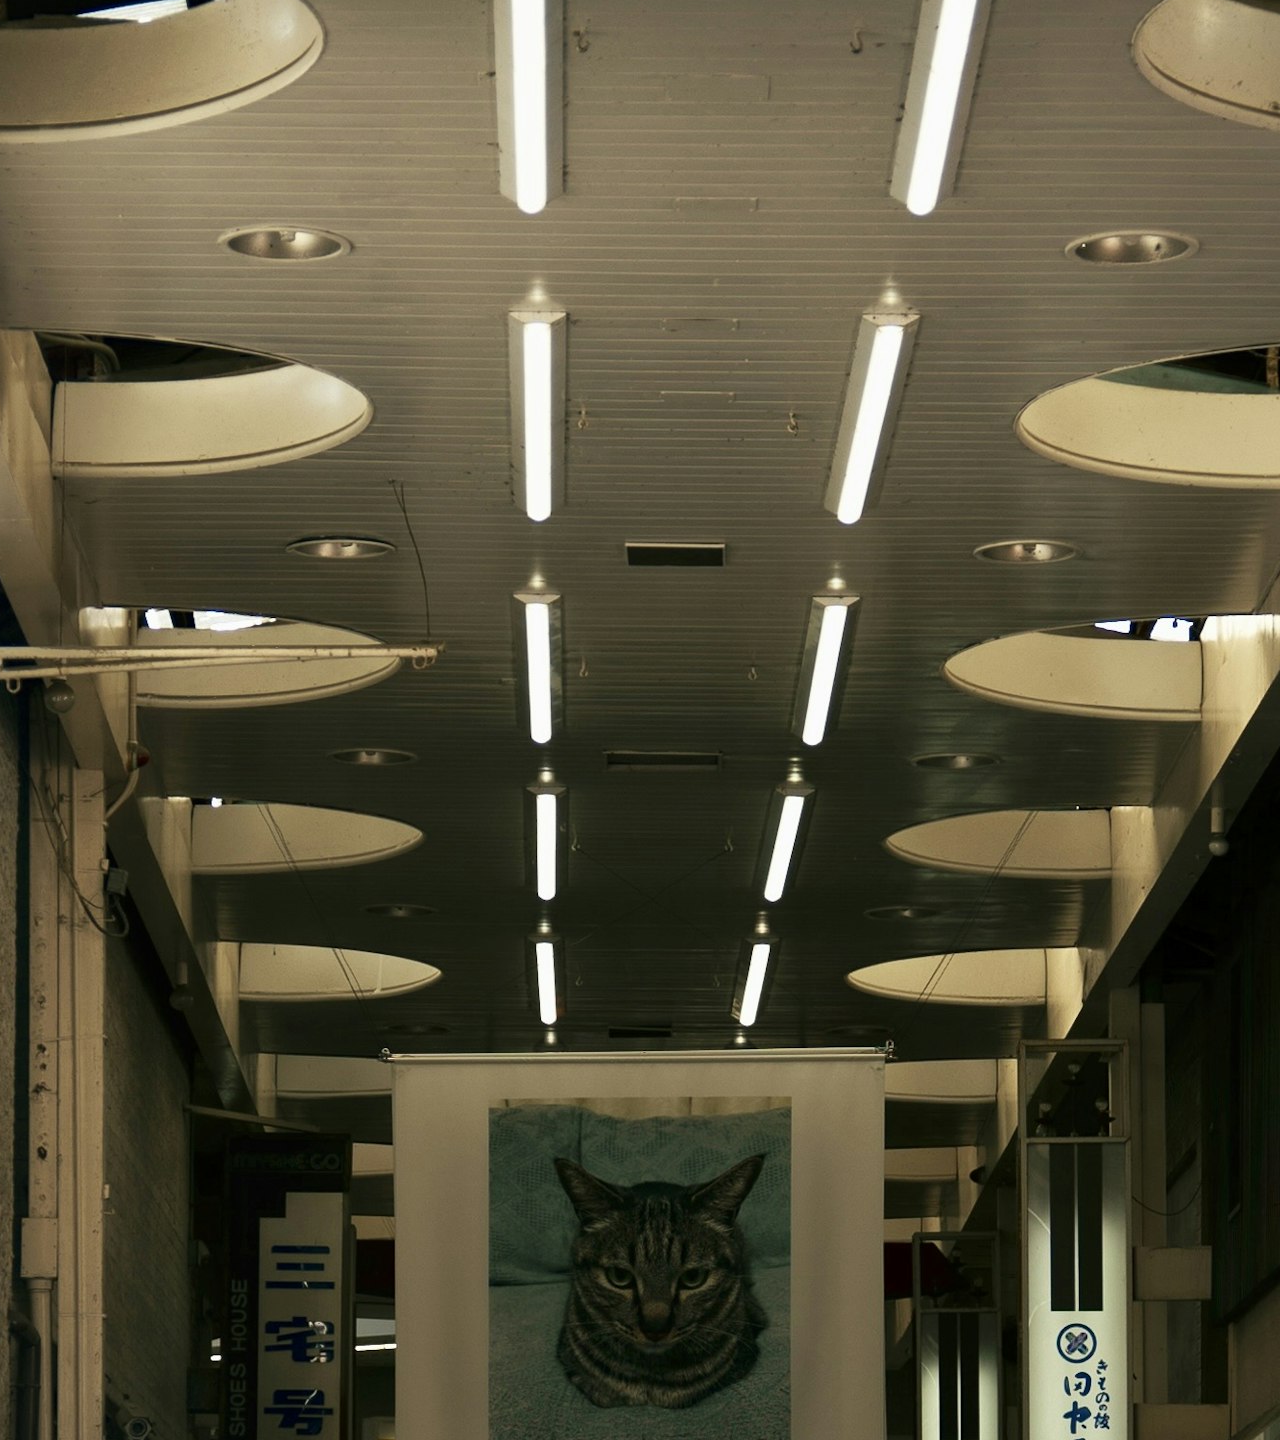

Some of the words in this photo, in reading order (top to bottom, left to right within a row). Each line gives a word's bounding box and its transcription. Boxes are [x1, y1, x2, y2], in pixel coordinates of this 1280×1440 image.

[229, 1278, 248, 1353] HOUSE
[263, 1244, 336, 1437] 三宅号
[229, 1361, 248, 1438] SHOES
